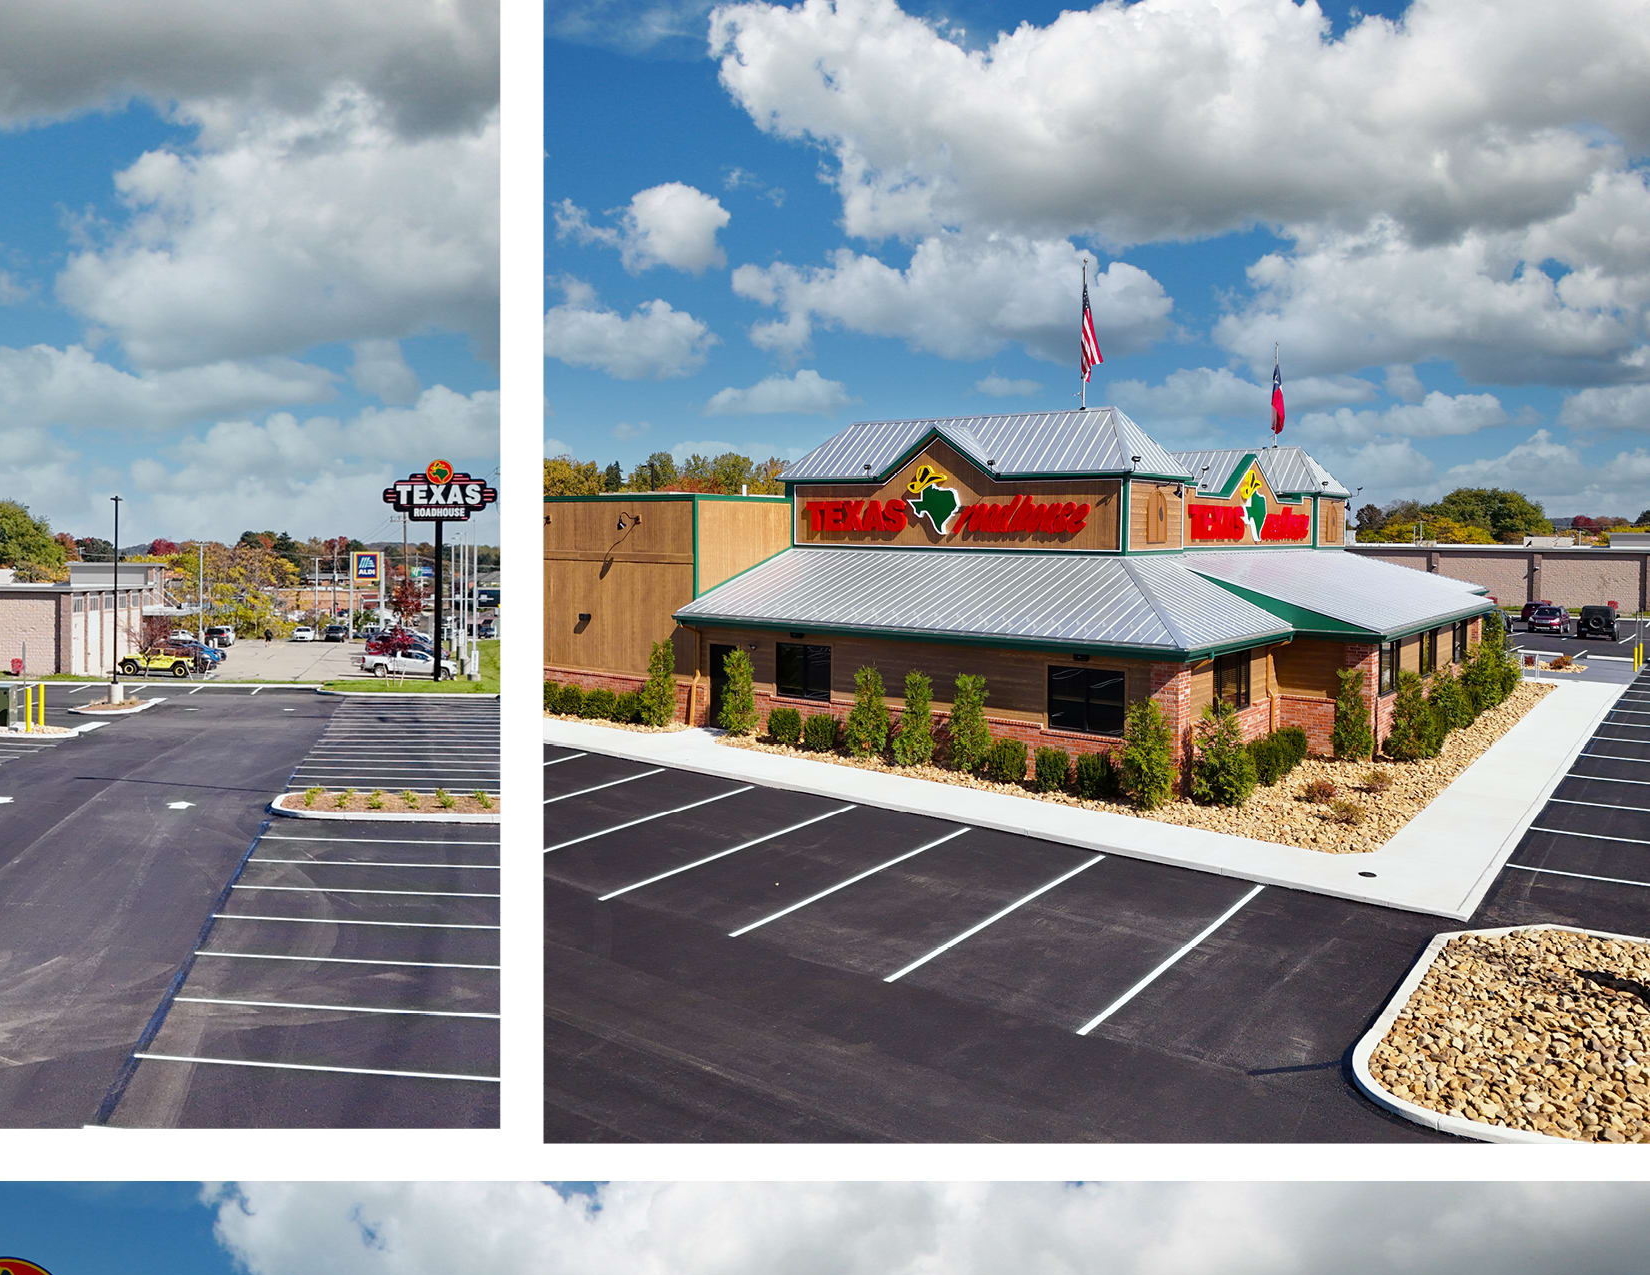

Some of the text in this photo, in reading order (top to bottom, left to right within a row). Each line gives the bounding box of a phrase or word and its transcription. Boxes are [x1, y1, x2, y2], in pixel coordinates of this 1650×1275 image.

[396, 485, 482, 505] TEXAS
[413, 508, 465, 517] ROADHOUSE
[805, 494, 1091, 535] TEXAS roadhouse
